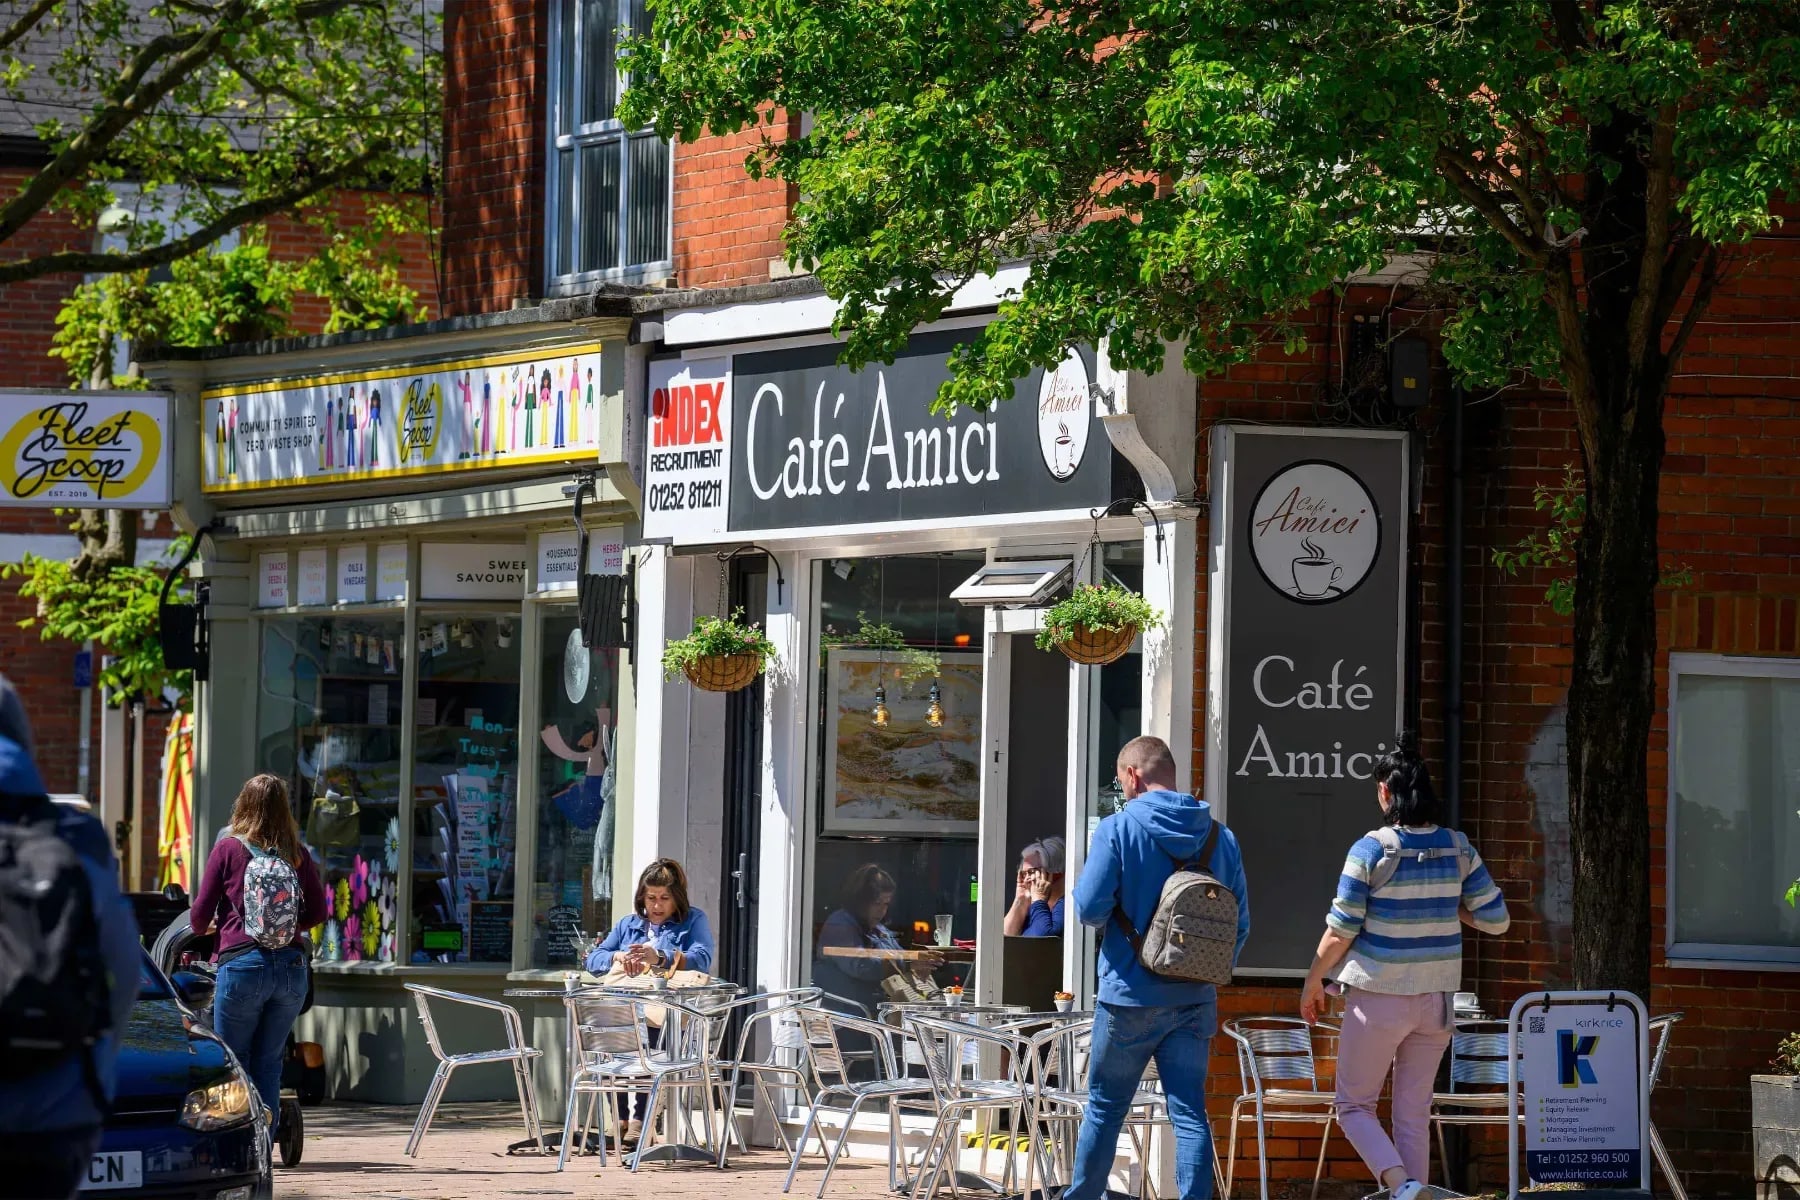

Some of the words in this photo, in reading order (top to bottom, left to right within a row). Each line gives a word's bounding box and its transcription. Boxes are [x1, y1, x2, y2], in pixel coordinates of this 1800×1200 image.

[408, 377, 435, 422] Fleet
[1040, 369, 1085, 420] Amici
[38, 401, 132, 452] Fleet
[240, 418, 282, 434] COMMUNITY
[284, 415, 317, 430] SPIRITED
[246, 440, 265, 452] ZERO
[267, 436, 291, 451] WASTE
[293, 434, 313, 448] SHOP
[747, 380, 849, 500] Café
[857, 371, 1000, 491] Amici
[12, 433, 126, 500] Scoop
[651, 449, 723, 472] RECRUITMENT
[650, 482, 685, 512] 01252
[689, 479, 722, 509] 811211
[1256, 486, 1366, 537] Amici
[1296, 496, 1329, 516] Café
[546, 547, 578, 559] HOUSEHOLD
[602, 544, 621, 554] HERBS
[546, 561, 578, 573] ESSENTIALS
[456, 572, 525, 583] SAVOURY
[1253, 655, 1374, 711] Café
[1576, 1018, 1624, 1028] kirkrice
[1580, 1096, 1607, 1105] Planning
[1546, 1116, 1579, 1124] Mortgages
[1546, 1126, 1577, 1134] Managing
[1579, 1125, 1615, 1133] Investments
[1579, 1135, 1606, 1144] Planning
[1558, 1153, 1588, 1163] 01252
[1591, 1152, 1609, 1163] 960
[1612, 1152, 1630, 1163] 500
[1539, 1168, 1628, 1179] www.kirkrice.co.uk
